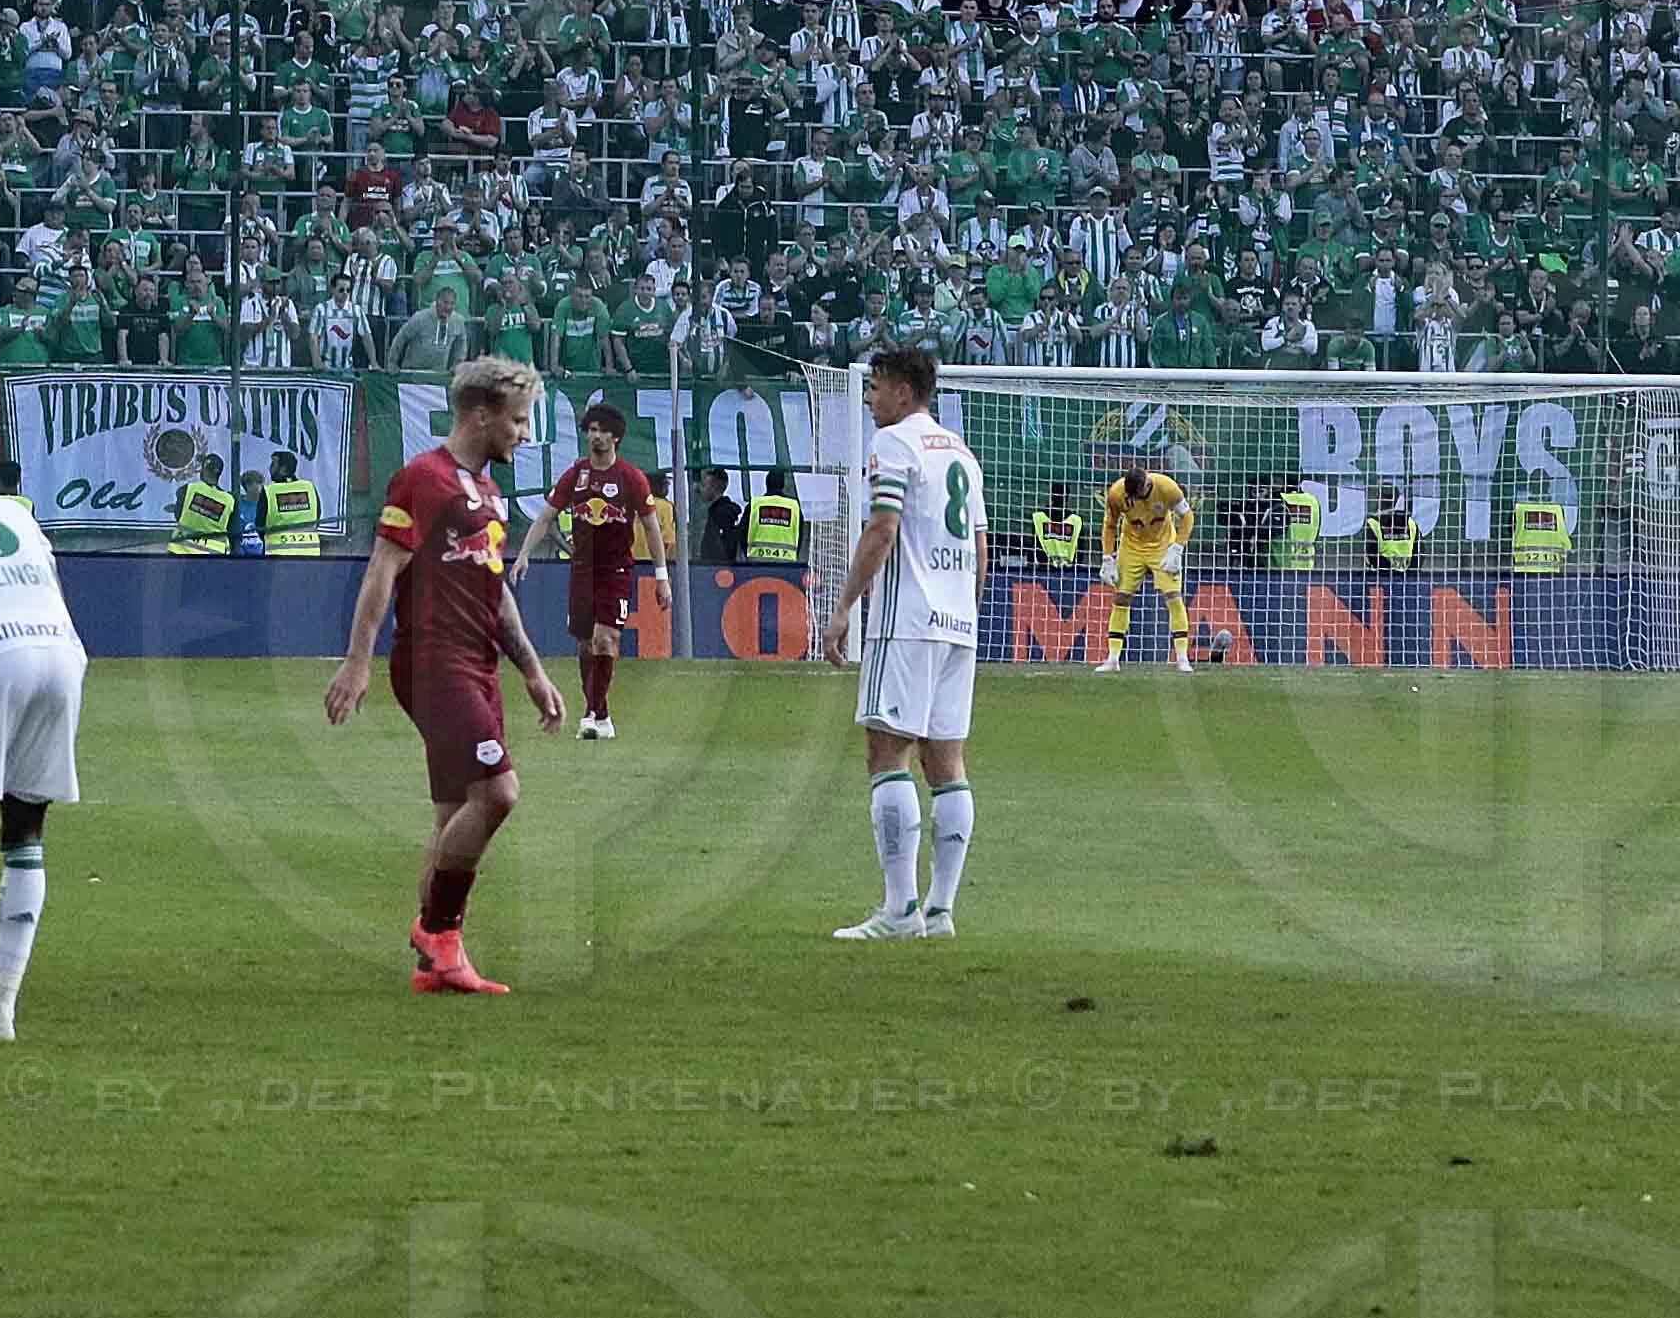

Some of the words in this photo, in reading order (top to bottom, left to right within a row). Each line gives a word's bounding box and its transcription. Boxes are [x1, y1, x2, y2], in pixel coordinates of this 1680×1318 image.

[38, 382, 188, 457] VIRIBUS
[56, 477, 145, 511] Old
[945, 461, 970, 540] 8
[928, 610, 973, 635] Allianz
